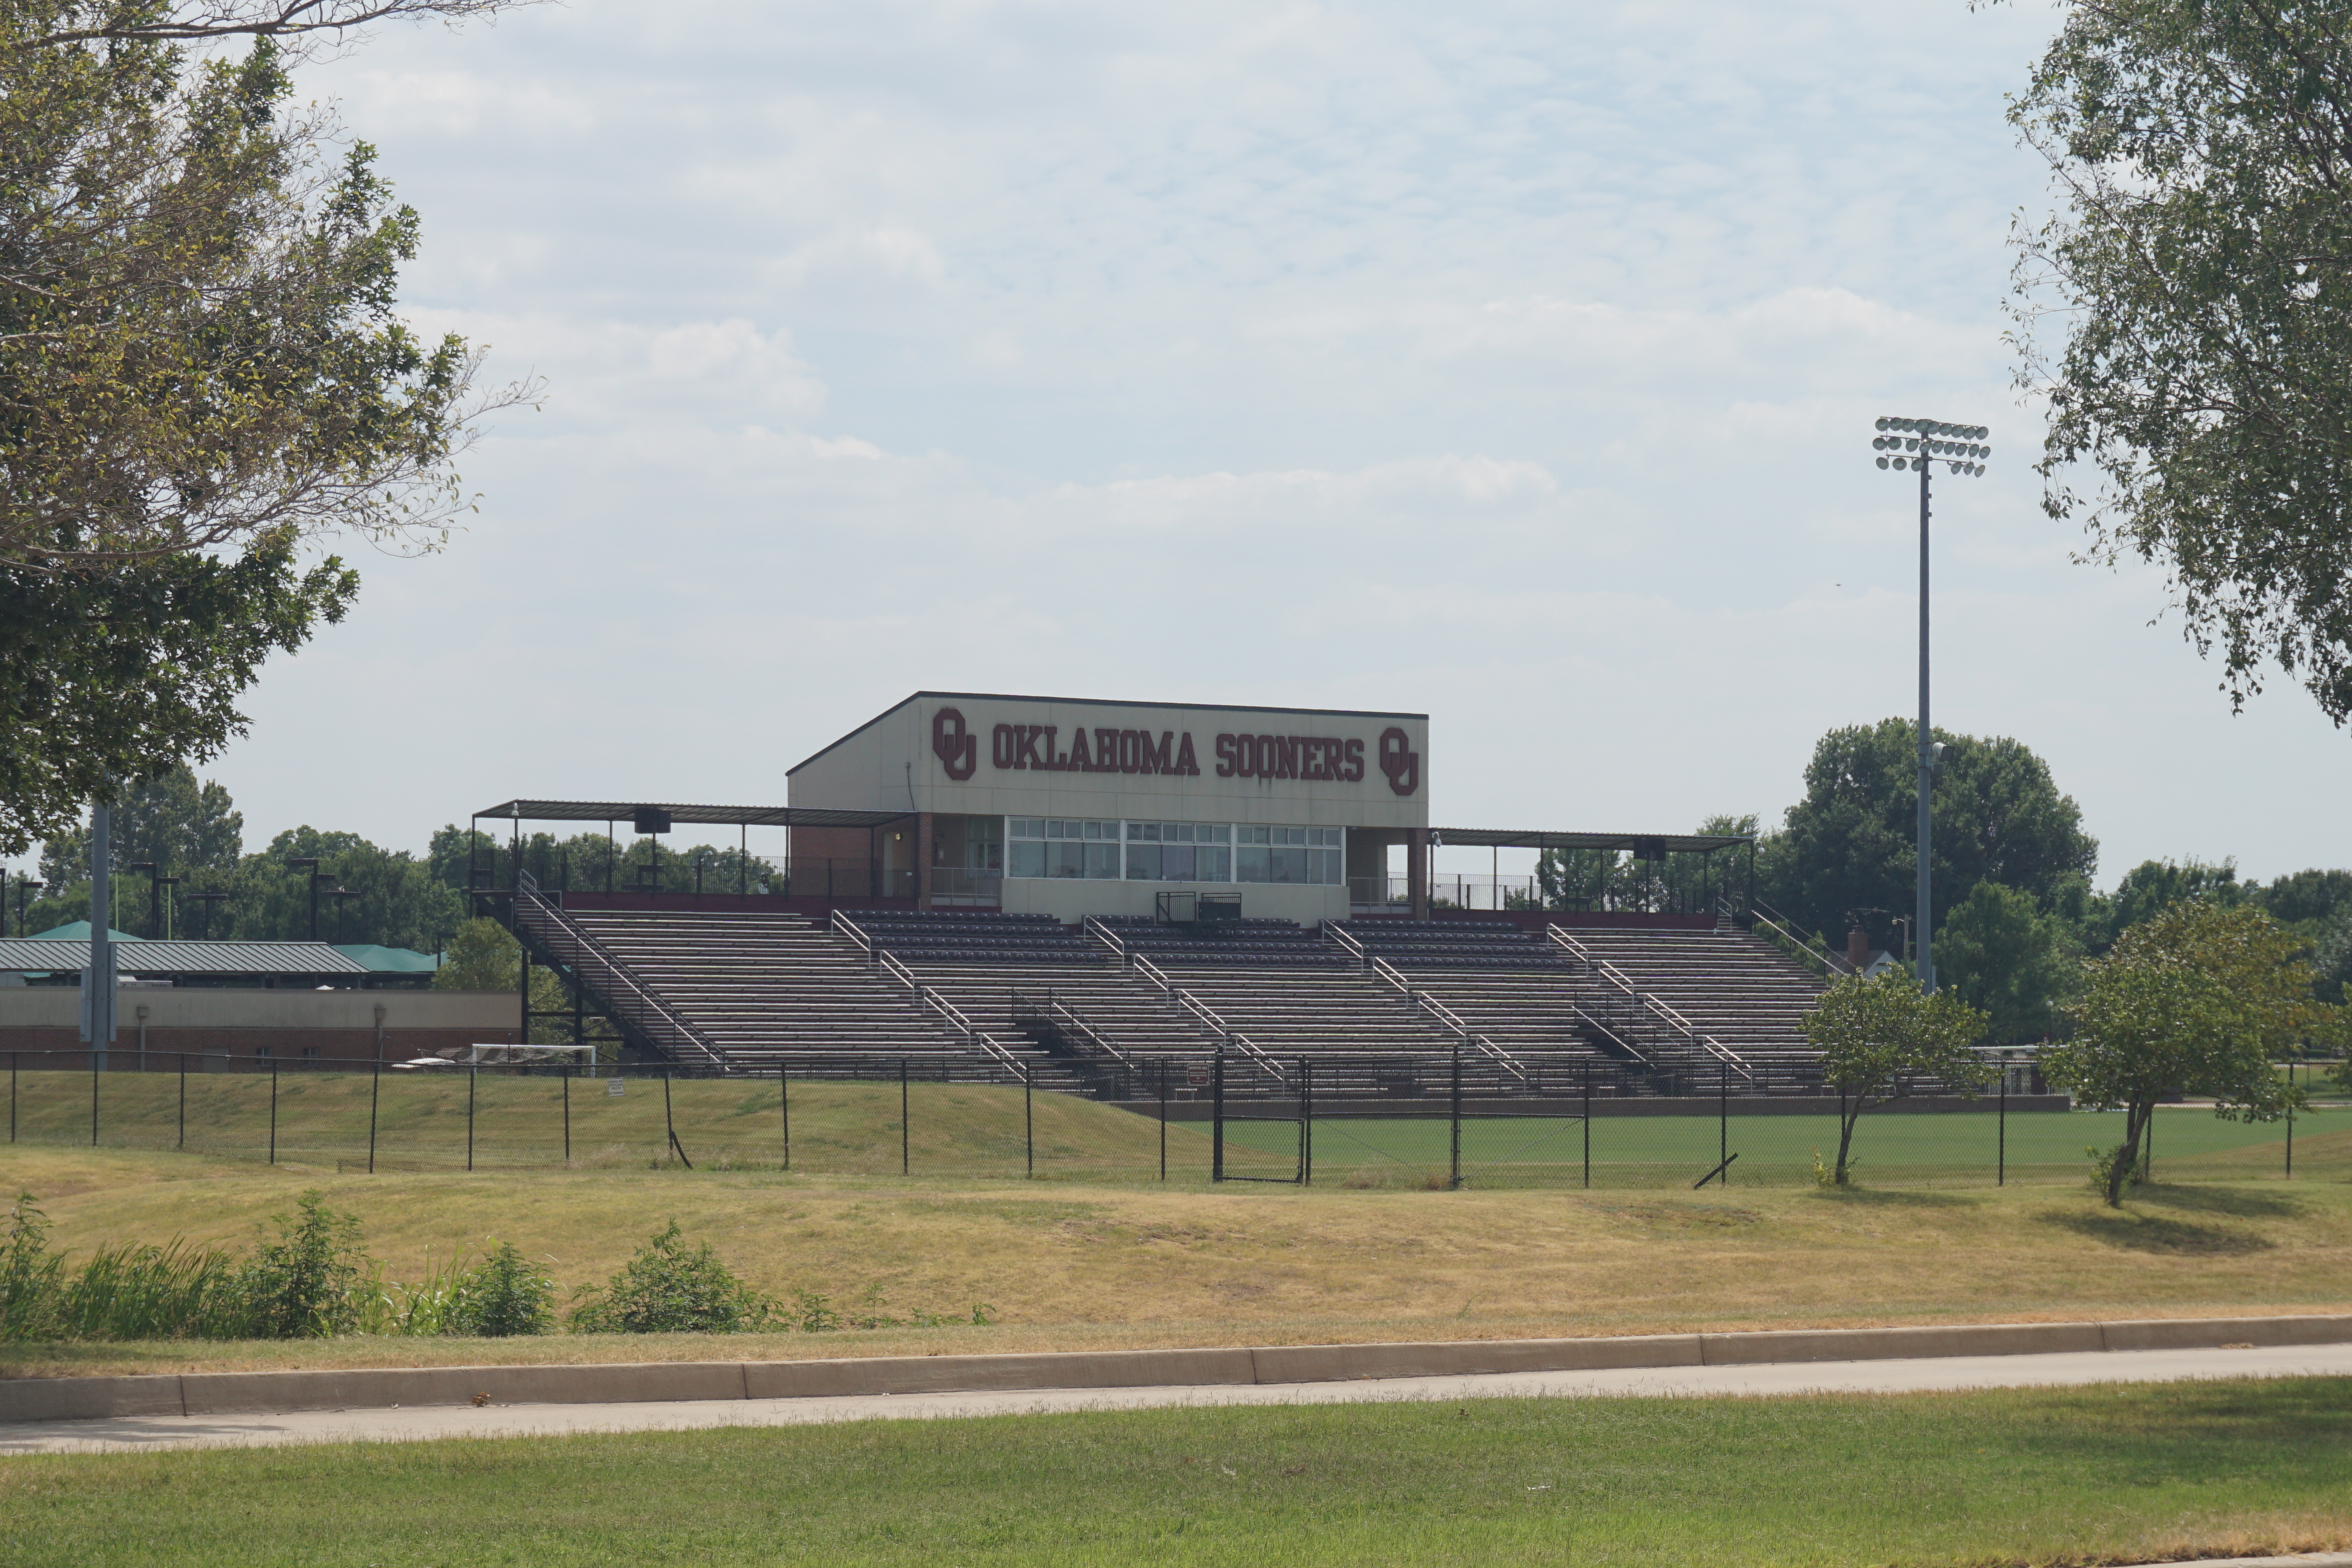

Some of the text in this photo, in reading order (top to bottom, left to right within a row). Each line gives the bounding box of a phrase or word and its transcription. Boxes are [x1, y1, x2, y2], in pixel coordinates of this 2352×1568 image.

[933, 708, 976, 780] OU
[993, 724, 1364, 782] OKLAHOMA SOONERS
[1380, 728, 1419, 796] OU
